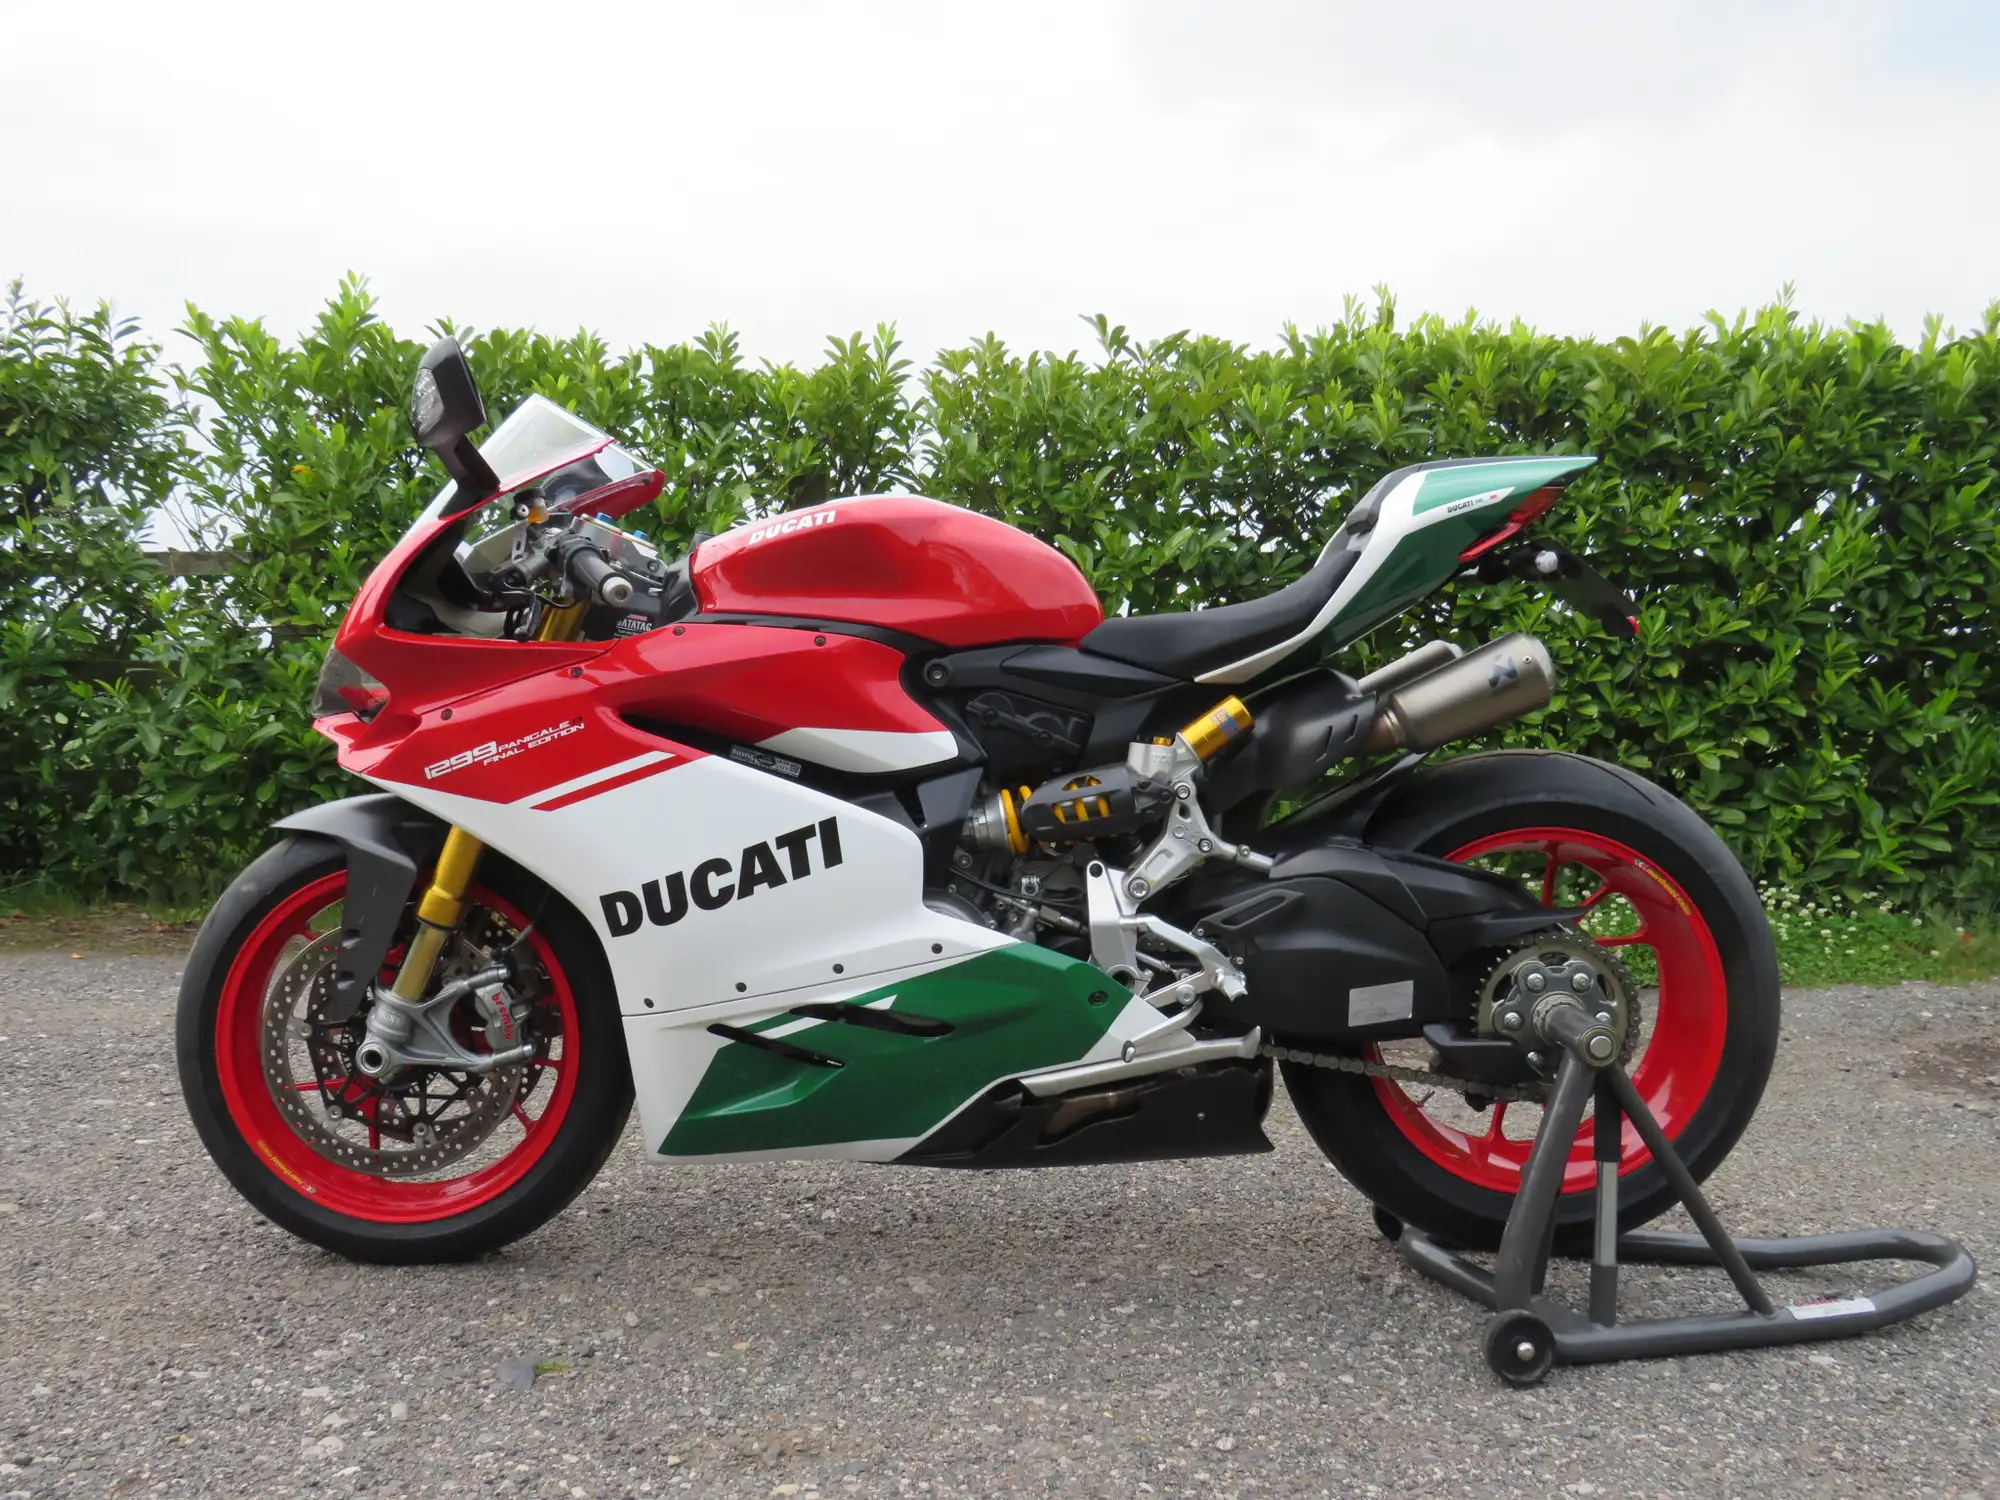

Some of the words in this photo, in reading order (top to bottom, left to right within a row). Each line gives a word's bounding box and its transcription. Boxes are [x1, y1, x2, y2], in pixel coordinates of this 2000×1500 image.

[749, 510, 836, 545] DUCATI
[1447, 500, 1474, 513] DUCATI
[424, 741, 497, 780] 1299
[498, 720, 571, 753] PANIGALE
[483, 748, 525, 766] FINAL
[528, 723, 585, 749] EDITION
[599, 816, 843, 938] DUCATI
[492, 991, 514, 1041] brembo
